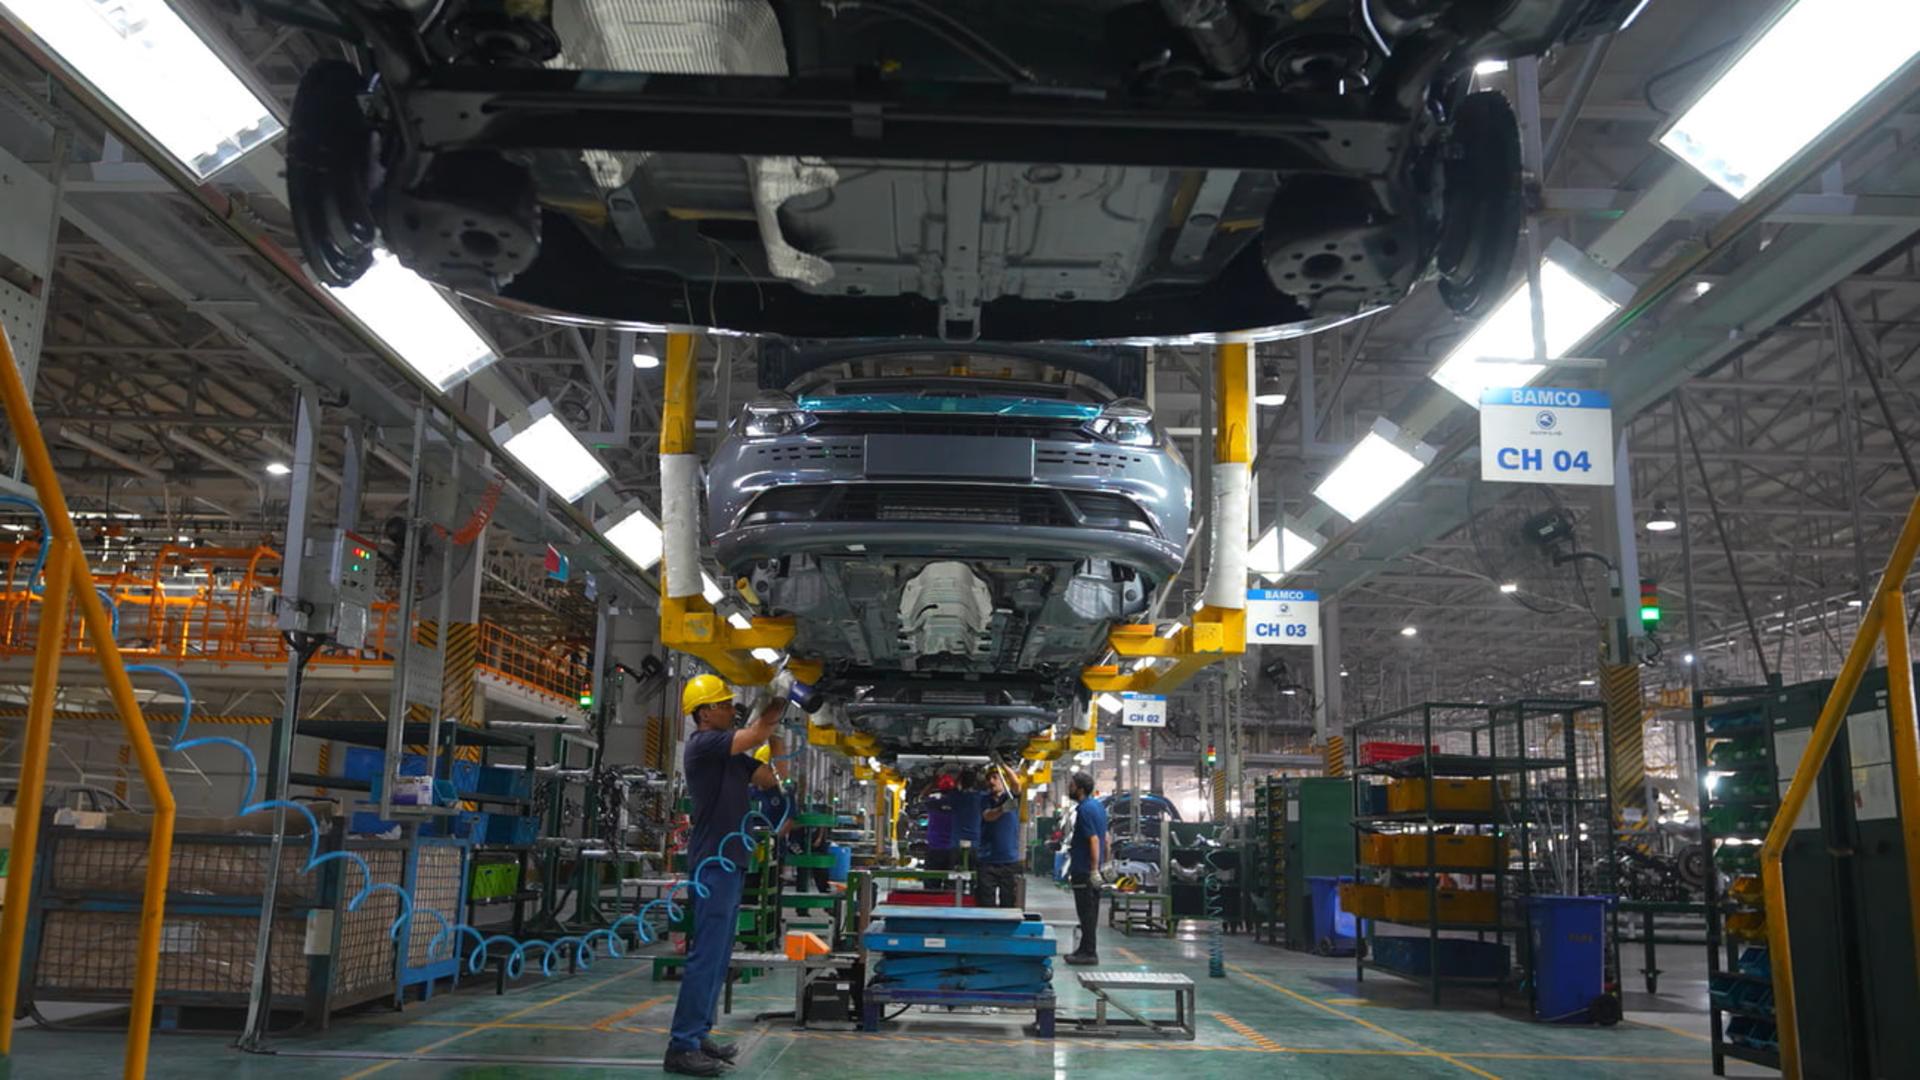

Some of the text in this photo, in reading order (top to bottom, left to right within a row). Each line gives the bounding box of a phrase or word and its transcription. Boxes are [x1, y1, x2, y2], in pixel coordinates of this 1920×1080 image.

[1512, 390, 1581, 406] BAMCO
[1497, 447, 1592, 472] CH 04
[1265, 591, 1304, 600] BAMCO
[1256, 623, 1307, 637] CH 03
[1147, 714, 1160, 723] 02
